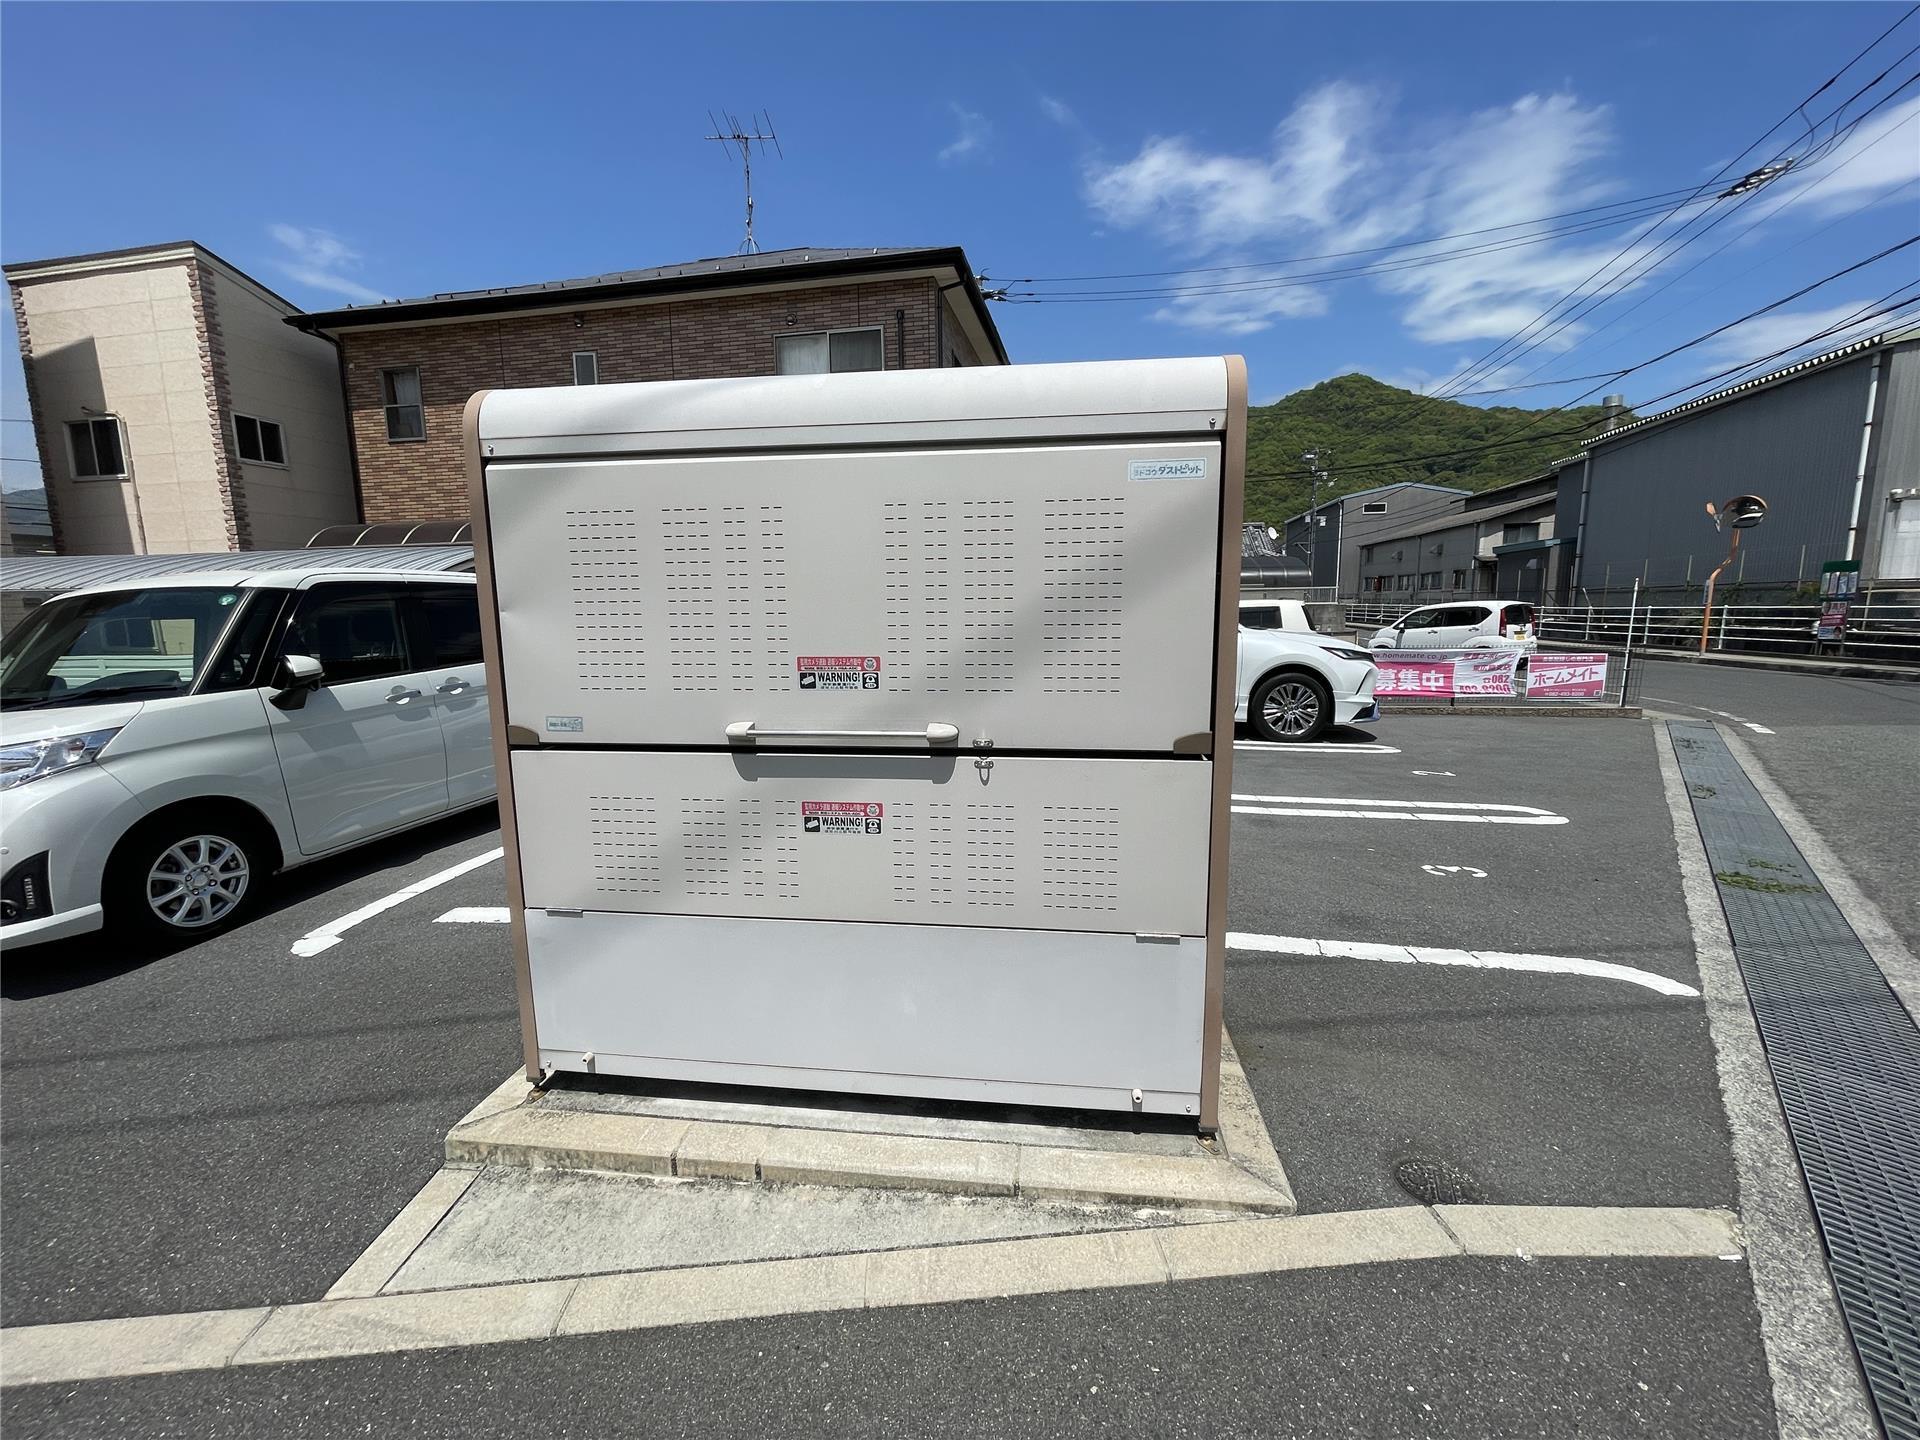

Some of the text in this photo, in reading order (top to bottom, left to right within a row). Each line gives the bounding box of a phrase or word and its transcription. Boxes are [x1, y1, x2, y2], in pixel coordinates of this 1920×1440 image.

[1158, 463, 1202, 475] ダストピット
[817, 672, 861, 682] WARNING!
[1375, 668, 1445, 691] 募集中
[1533, 667, 1599, 686] ホームメイト
[821, 816, 864, 827] WARNING!
